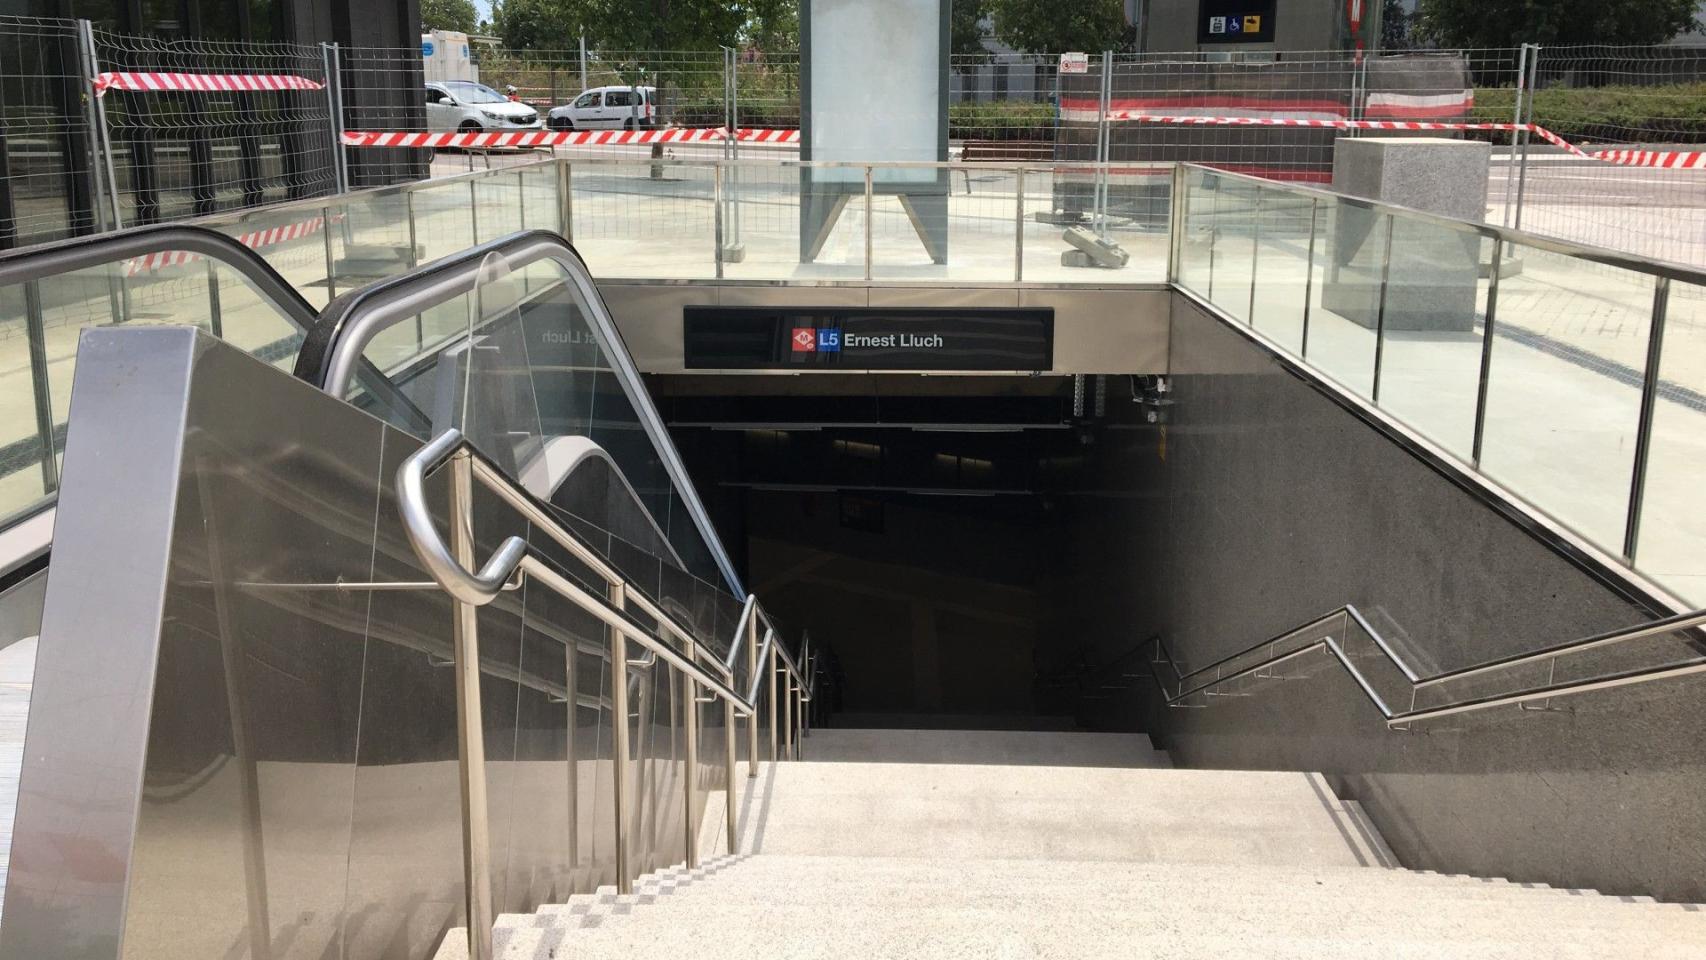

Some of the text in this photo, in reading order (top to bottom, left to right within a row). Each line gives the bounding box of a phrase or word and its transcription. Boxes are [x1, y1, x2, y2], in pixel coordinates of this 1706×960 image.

[819, 333, 838, 346] L5
[844, 333, 896, 347] Ernest
[900, 333, 943, 348] Lluch
